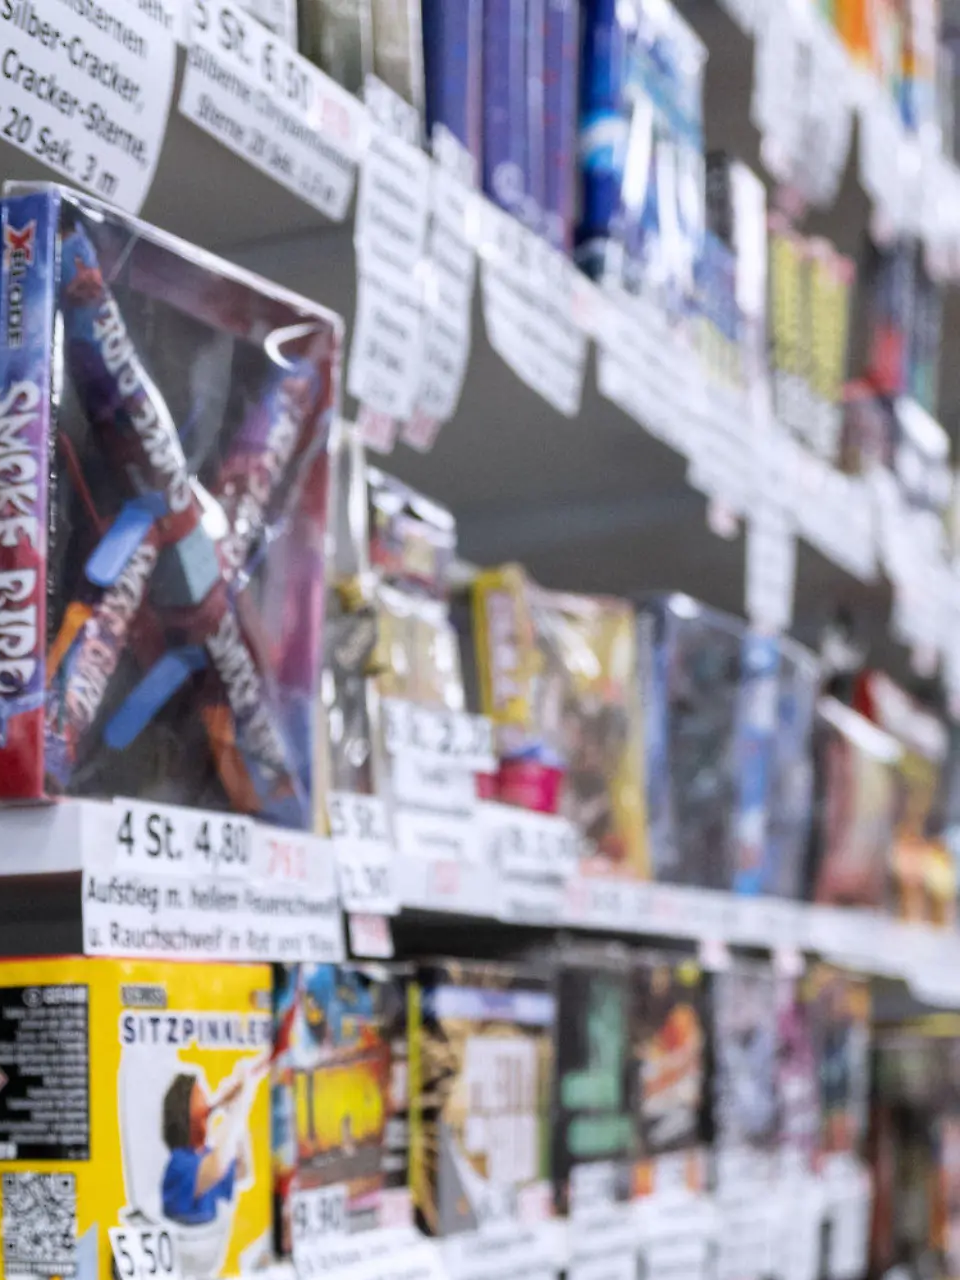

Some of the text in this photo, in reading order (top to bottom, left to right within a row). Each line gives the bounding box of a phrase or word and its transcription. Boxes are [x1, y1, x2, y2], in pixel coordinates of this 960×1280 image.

[2, 106, 33, 144] 20
[117, 810, 252, 868] 4 St. 4,80
[87, 876, 159, 914] Aufstieg
